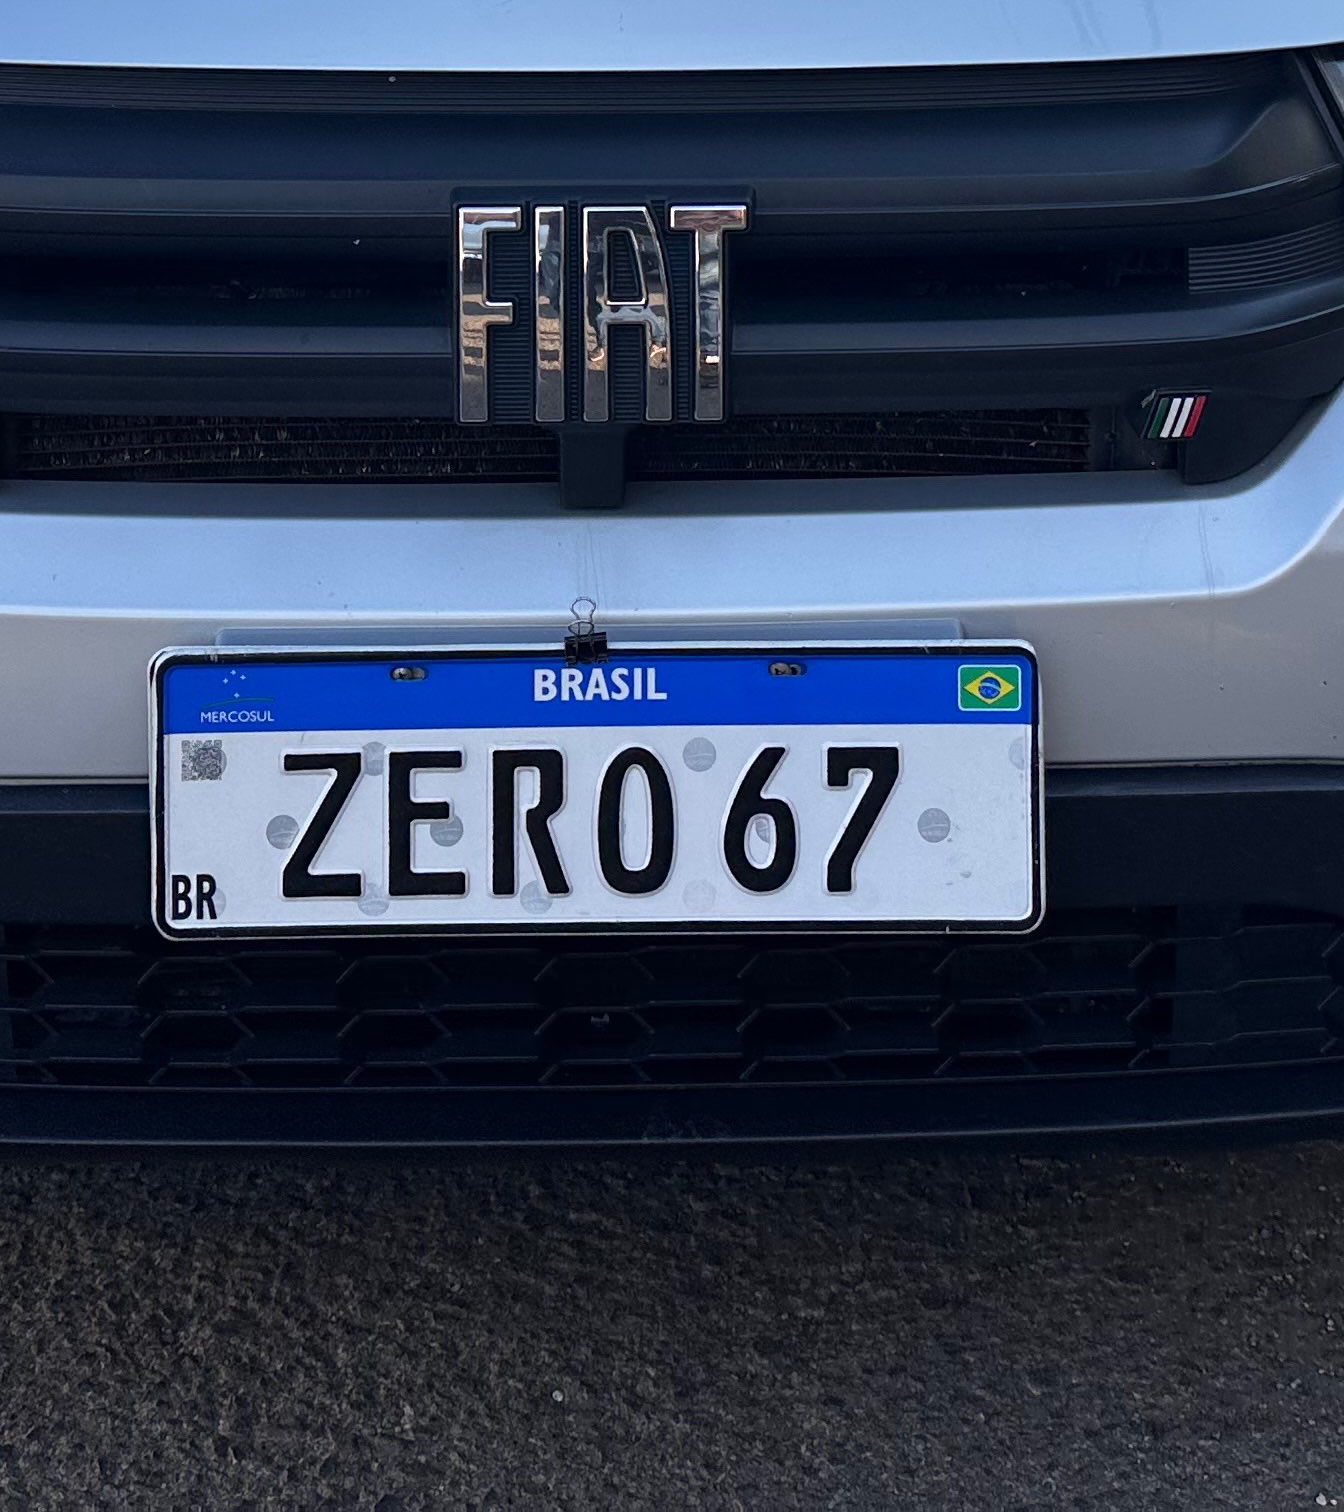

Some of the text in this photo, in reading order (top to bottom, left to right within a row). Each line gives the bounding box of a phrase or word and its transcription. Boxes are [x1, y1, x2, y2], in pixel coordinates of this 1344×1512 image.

[458, 205, 748, 422] FIAT
[532, 667, 668, 701] BRASIL
[200, 710, 275, 724] MERCOSUL
[281, 745, 902, 899] ZERO 67
[170, 873, 218, 921] BR
